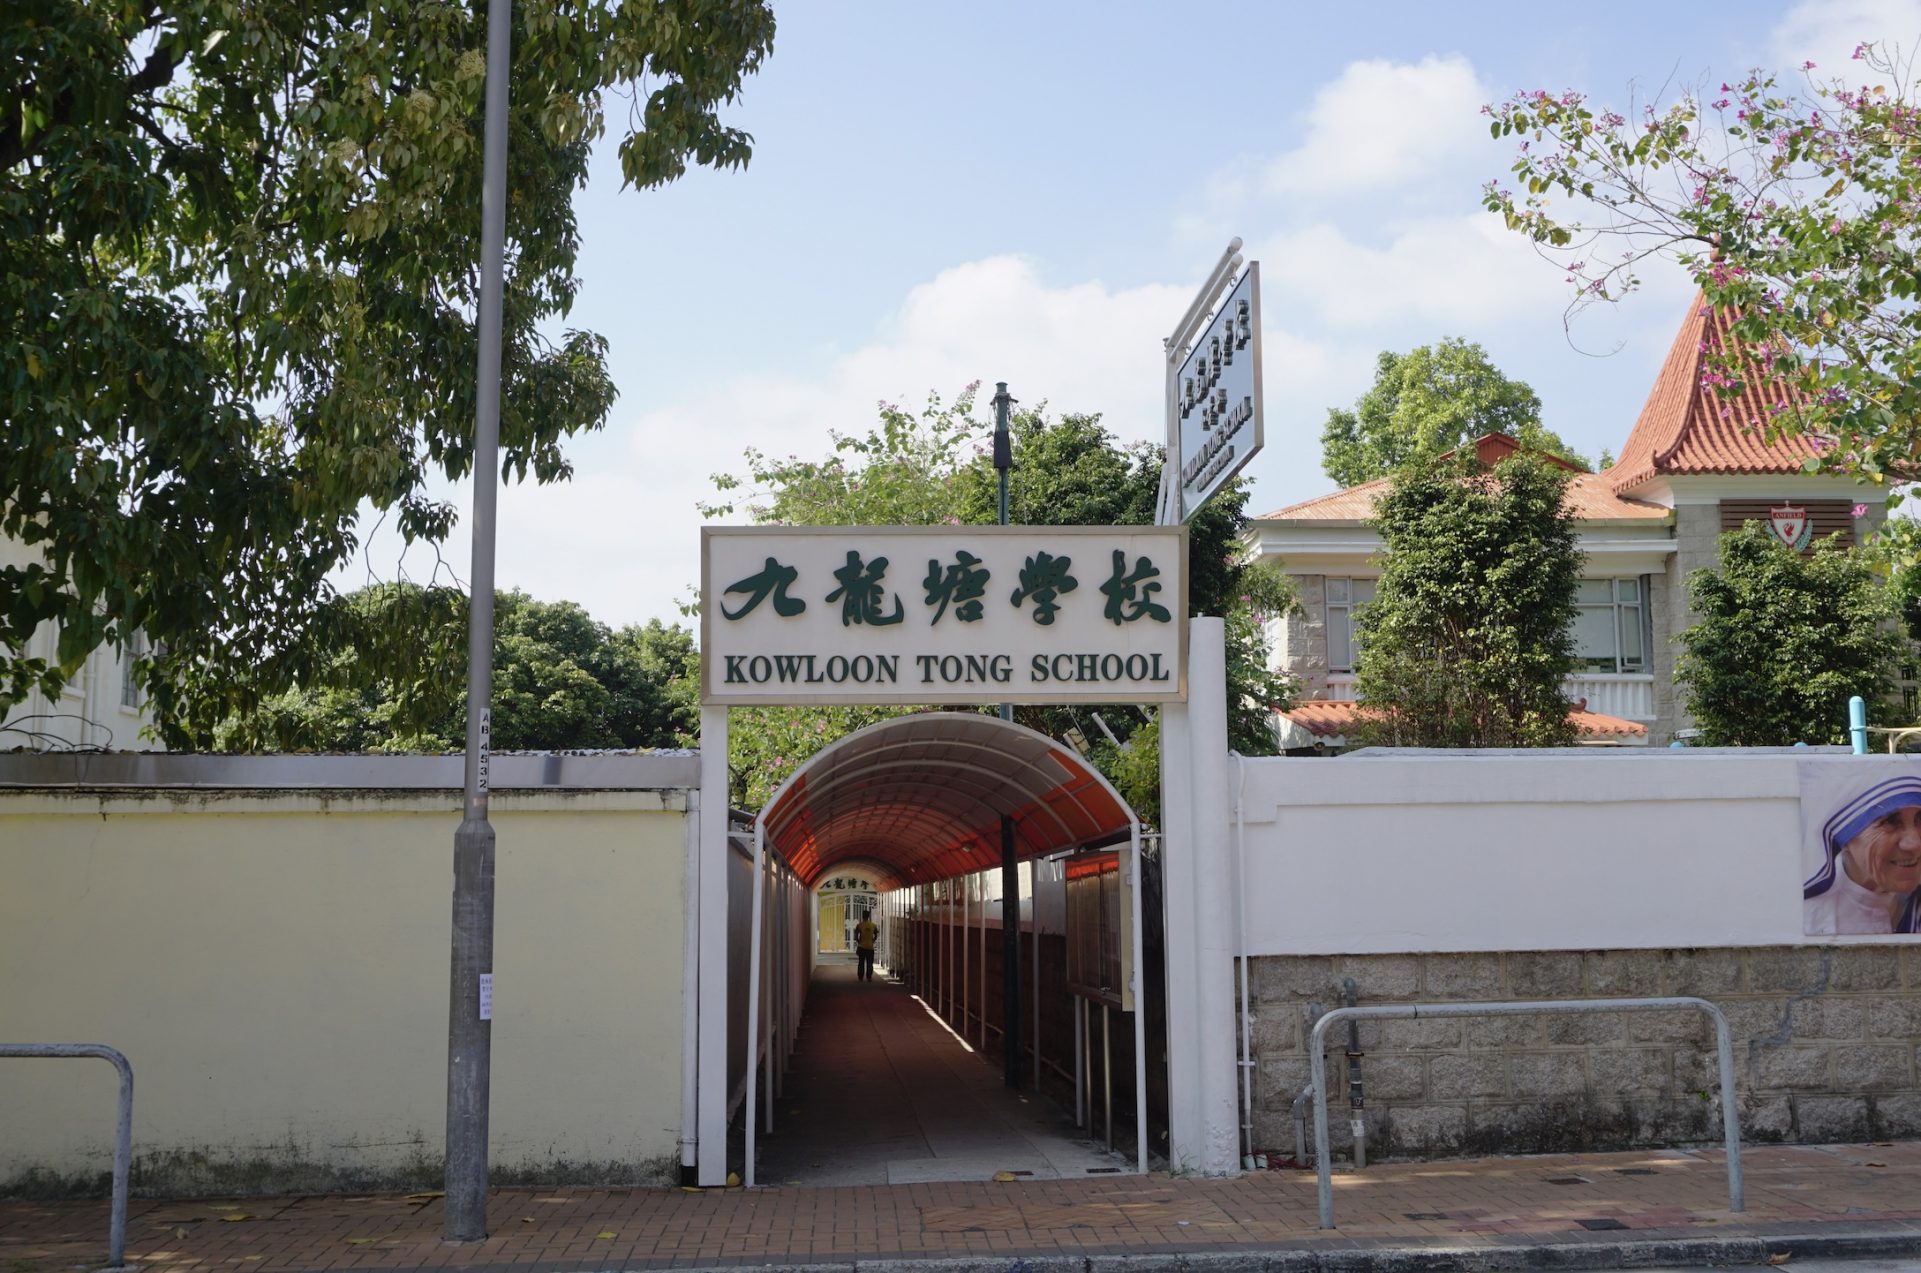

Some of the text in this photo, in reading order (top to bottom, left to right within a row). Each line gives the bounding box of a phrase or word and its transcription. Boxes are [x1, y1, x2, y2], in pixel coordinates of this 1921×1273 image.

[720, 549, 1172, 627] 九龍塘學校
[723, 653, 1170, 684] KOWLOON TONG SCHOOL
[479, 713, 490, 789] AB 4532
